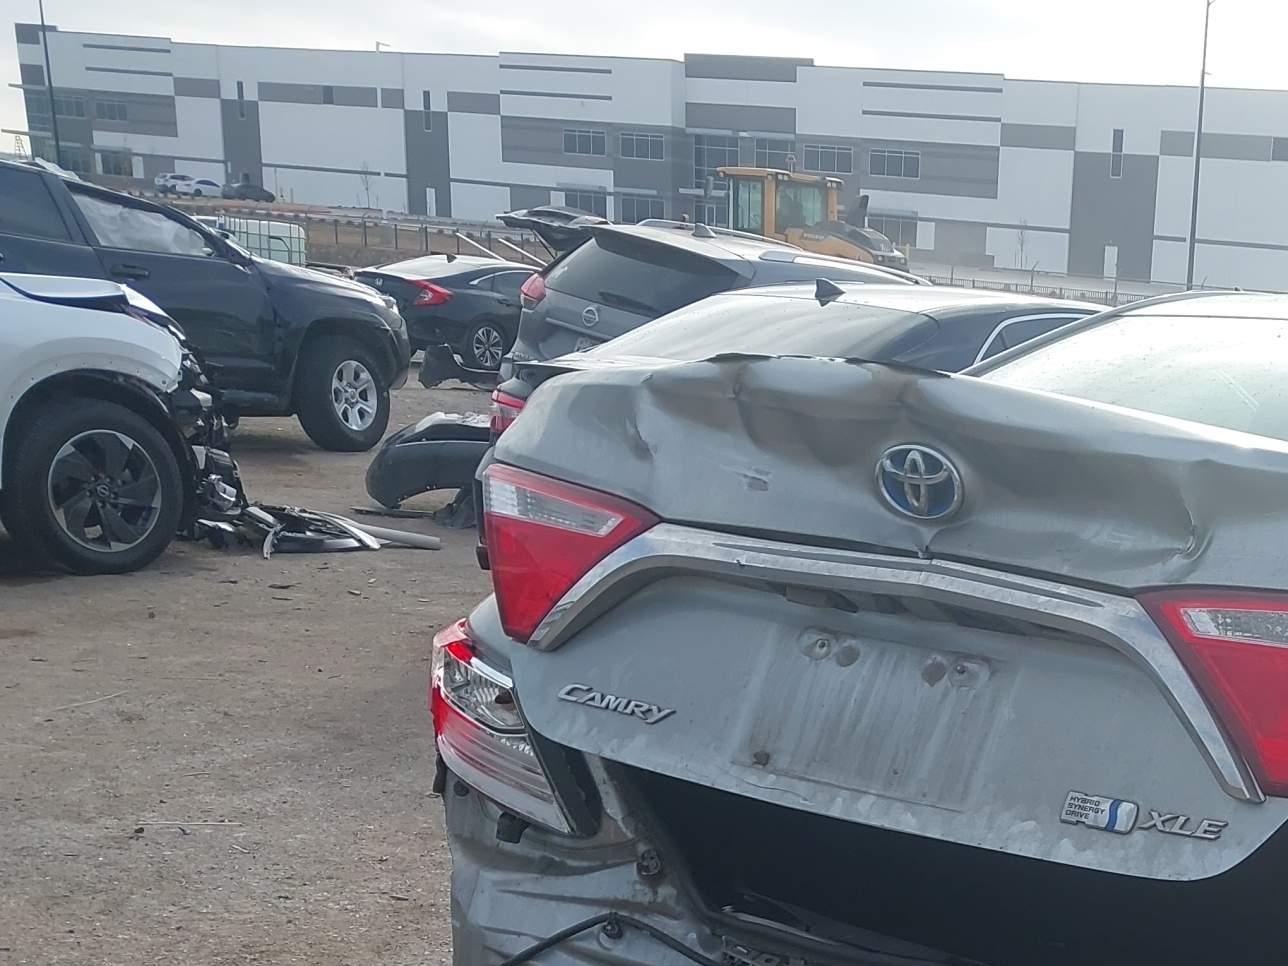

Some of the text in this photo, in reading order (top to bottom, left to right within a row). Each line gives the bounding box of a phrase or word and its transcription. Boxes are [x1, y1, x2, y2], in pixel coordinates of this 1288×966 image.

[557, 683, 677, 725] CAMRY
[1069, 796, 1101, 807] HYBRID
[1065, 809, 1090, 820] DRIVE
[1067, 802, 1106, 815] SYNERGY
[1136, 810, 1228, 840] XLE
